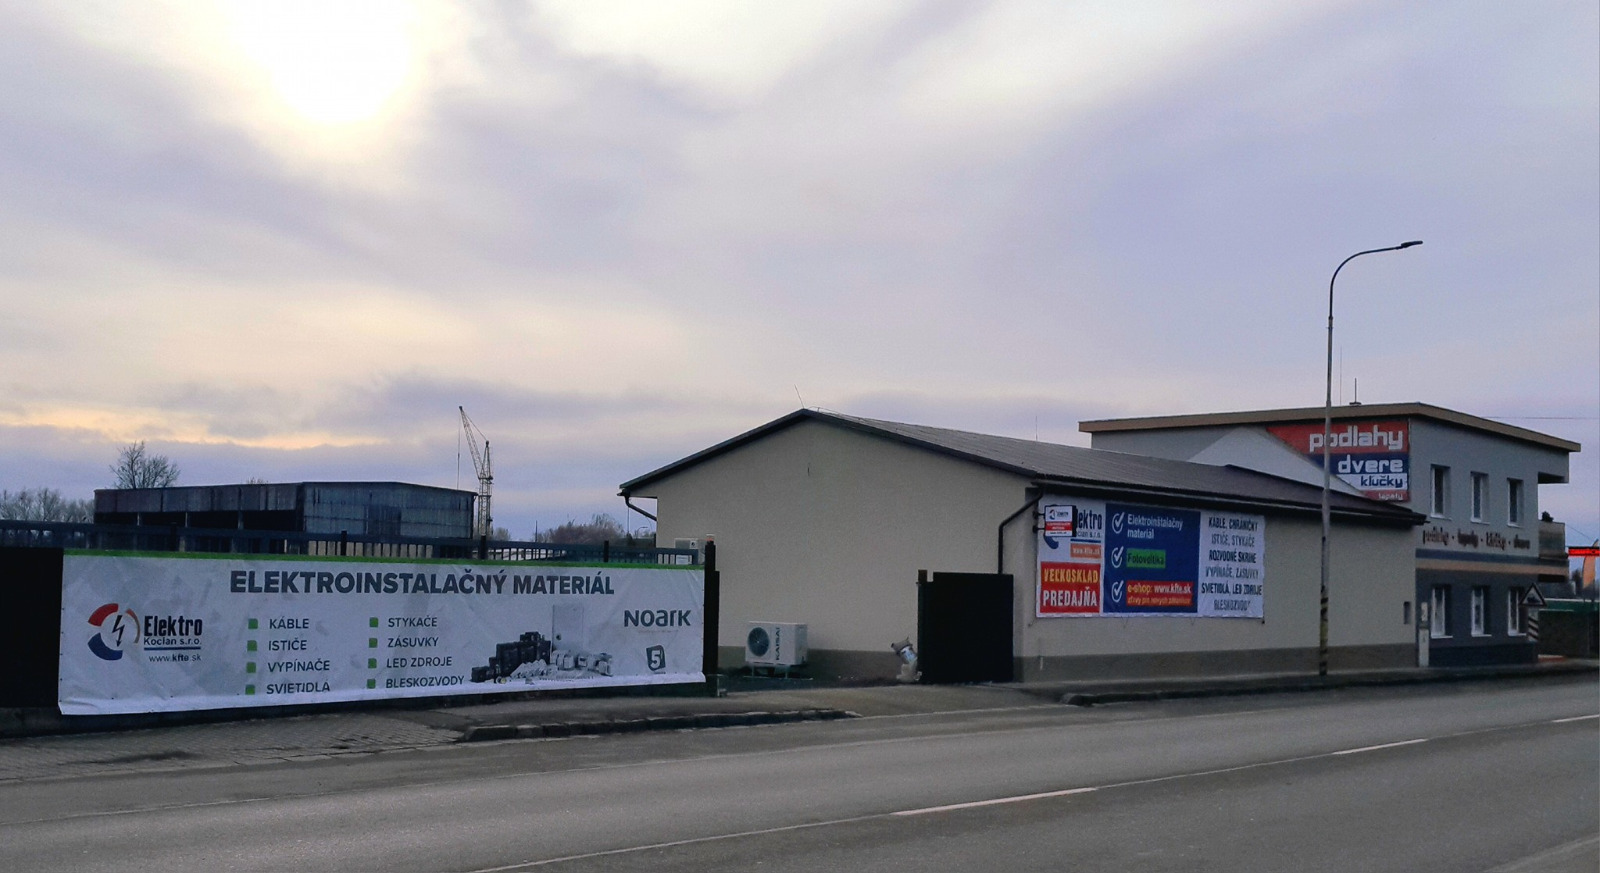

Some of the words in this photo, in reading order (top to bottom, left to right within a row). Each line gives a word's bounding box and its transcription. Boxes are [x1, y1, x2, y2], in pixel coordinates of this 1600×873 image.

[1309, 424, 1403, 452] podlahy
[1338, 454, 1403, 473] dvere
[230, 568, 508, 594] ELEKTROINSTALAČNÝ
[513, 571, 615, 595] MATERIÁL
[1043, 586, 1098, 606] PREDAJŇA
[143, 615, 203, 637] Elektro
[269, 617, 310, 630] KÁBLE
[387, 615, 438, 628] STYKAČE
[179, 637, 202, 646] s.r.o.
[268, 638, 307, 651] ISTIČE
[387, 636, 439, 648] ZÁSUVKY
[267, 658, 330, 673] VYPÍNAČE
[386, 657, 408, 669] LED
[410, 656, 453, 668] ZDROJE
[650, 649, 661, 669] 5
[266, 680, 330, 695] SVIETIDLÁ
[385, 675, 465, 689] BLESKOZVODY
